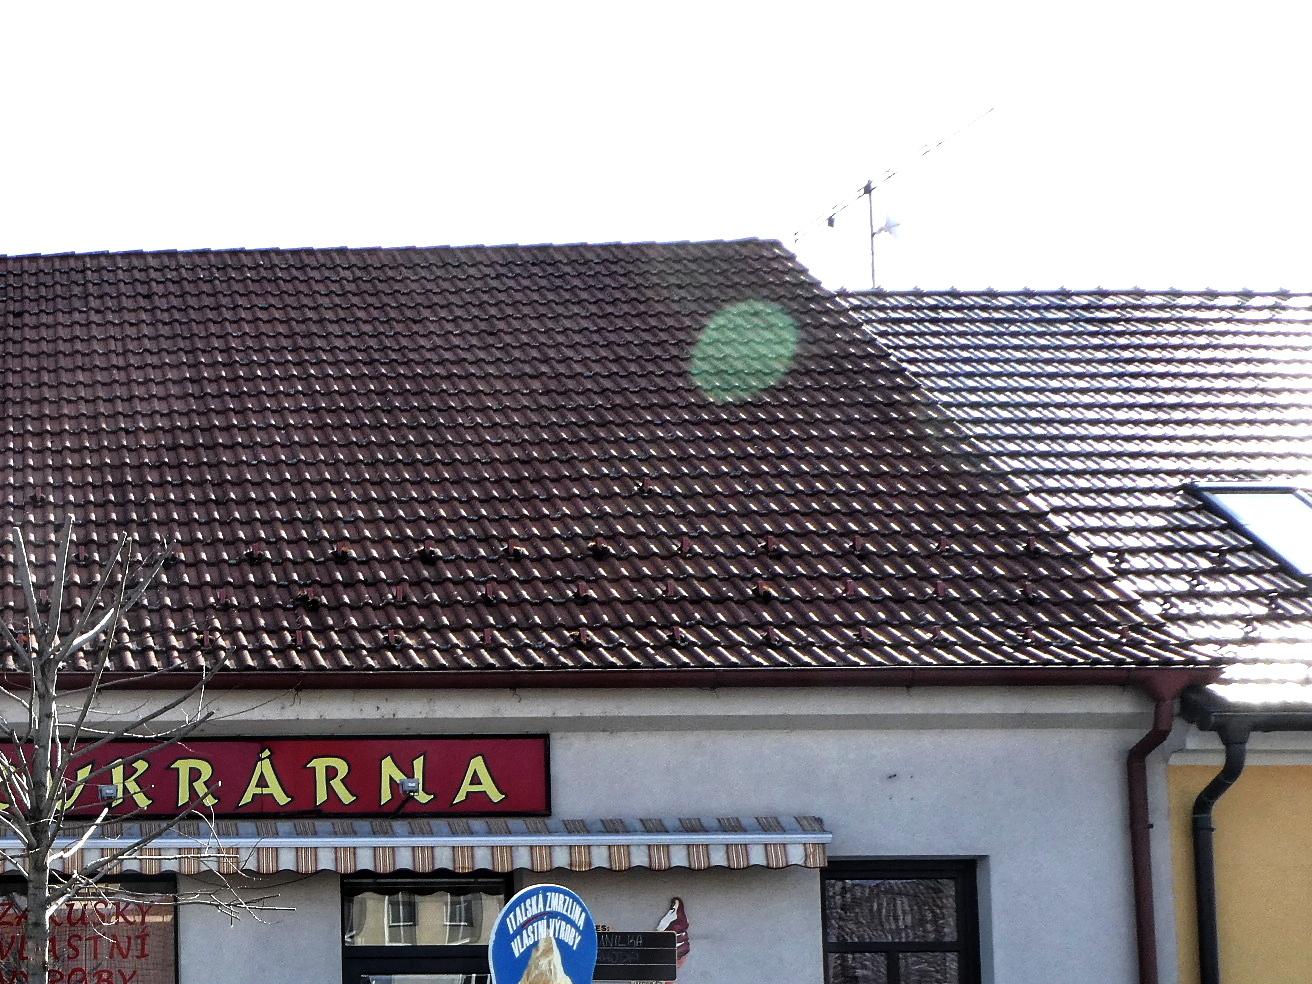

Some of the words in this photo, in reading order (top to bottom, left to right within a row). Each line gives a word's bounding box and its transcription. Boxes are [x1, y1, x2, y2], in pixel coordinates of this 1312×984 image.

[506, 890, 545, 935] ITALSKÁ
[545, 892, 586, 931] ZMRZLINA
[511, 916, 548, 958] VLASTNÍ
[549, 916, 581, 950] VÝROBY
